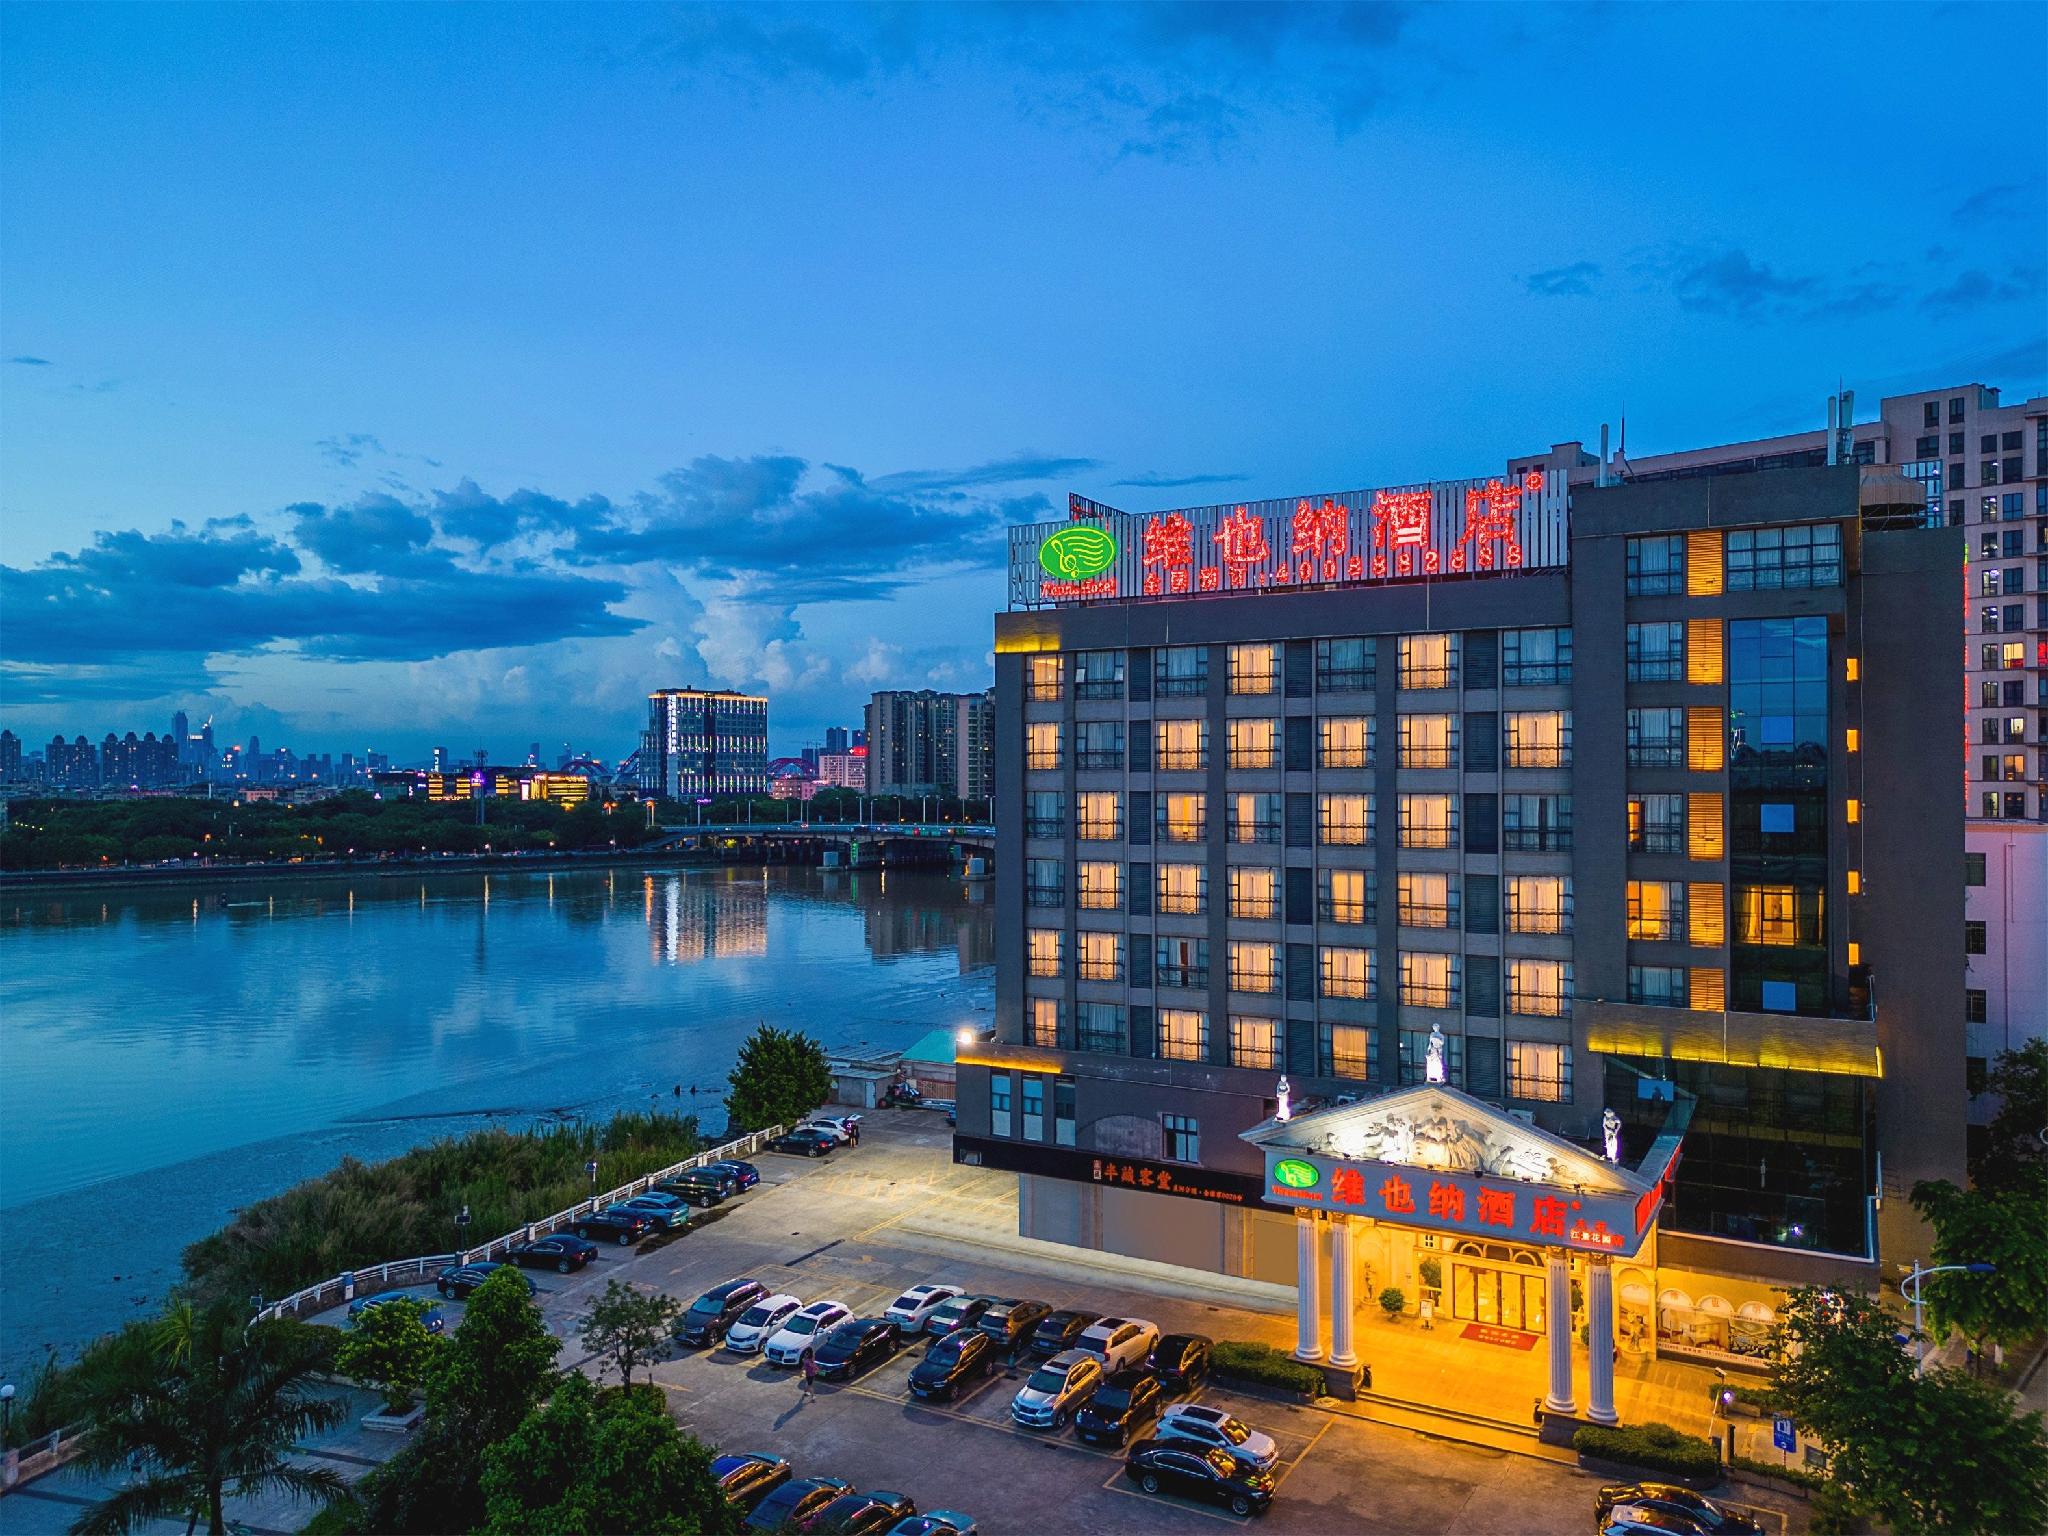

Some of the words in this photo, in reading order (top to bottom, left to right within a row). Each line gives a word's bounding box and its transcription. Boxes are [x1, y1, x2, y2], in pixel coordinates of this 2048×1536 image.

[1143, 481, 1523, 568] 维也纳酒店
[1331, 1168, 1567, 1236] 维也纳酒店
